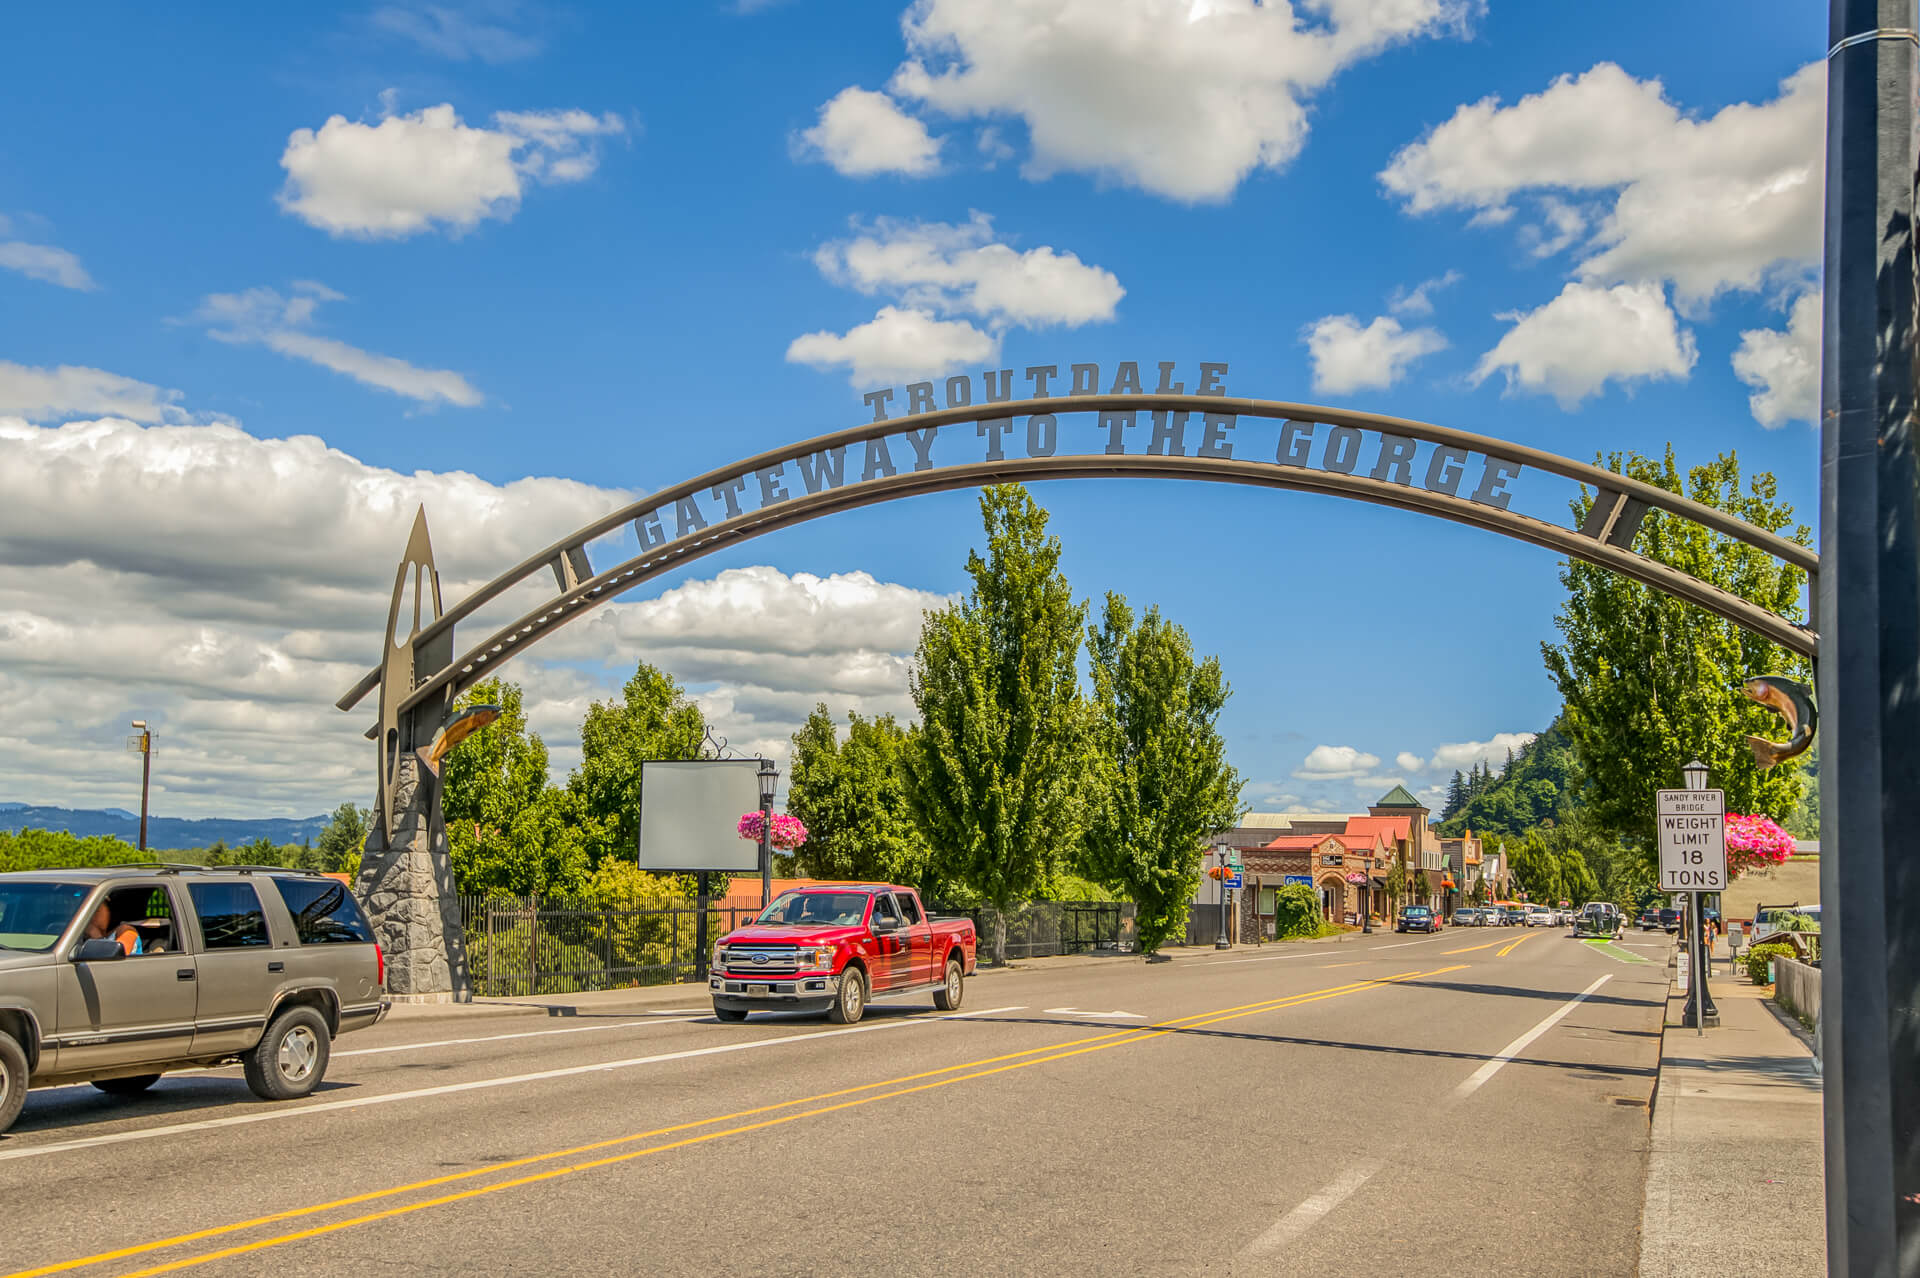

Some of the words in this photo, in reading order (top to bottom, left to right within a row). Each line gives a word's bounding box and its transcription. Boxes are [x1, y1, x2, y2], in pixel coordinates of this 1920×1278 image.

[864, 361, 1229, 423] TROUTDALE
[635, 427, 937, 553] GATEWAY
[977, 414, 1057, 461] TO
[1098, 410, 1237, 459] THE
[1277, 419, 1522, 510] GORGE
[1664, 794, 1689, 802] SANDY
[1676, 804, 1705, 812] BRIDGE
[1665, 818, 1717, 829] WEIGHT
[1673, 834, 1710, 845] LIMIT
[1682, 850, 1703, 865] 18
[1668, 871, 1719, 885] TONS
